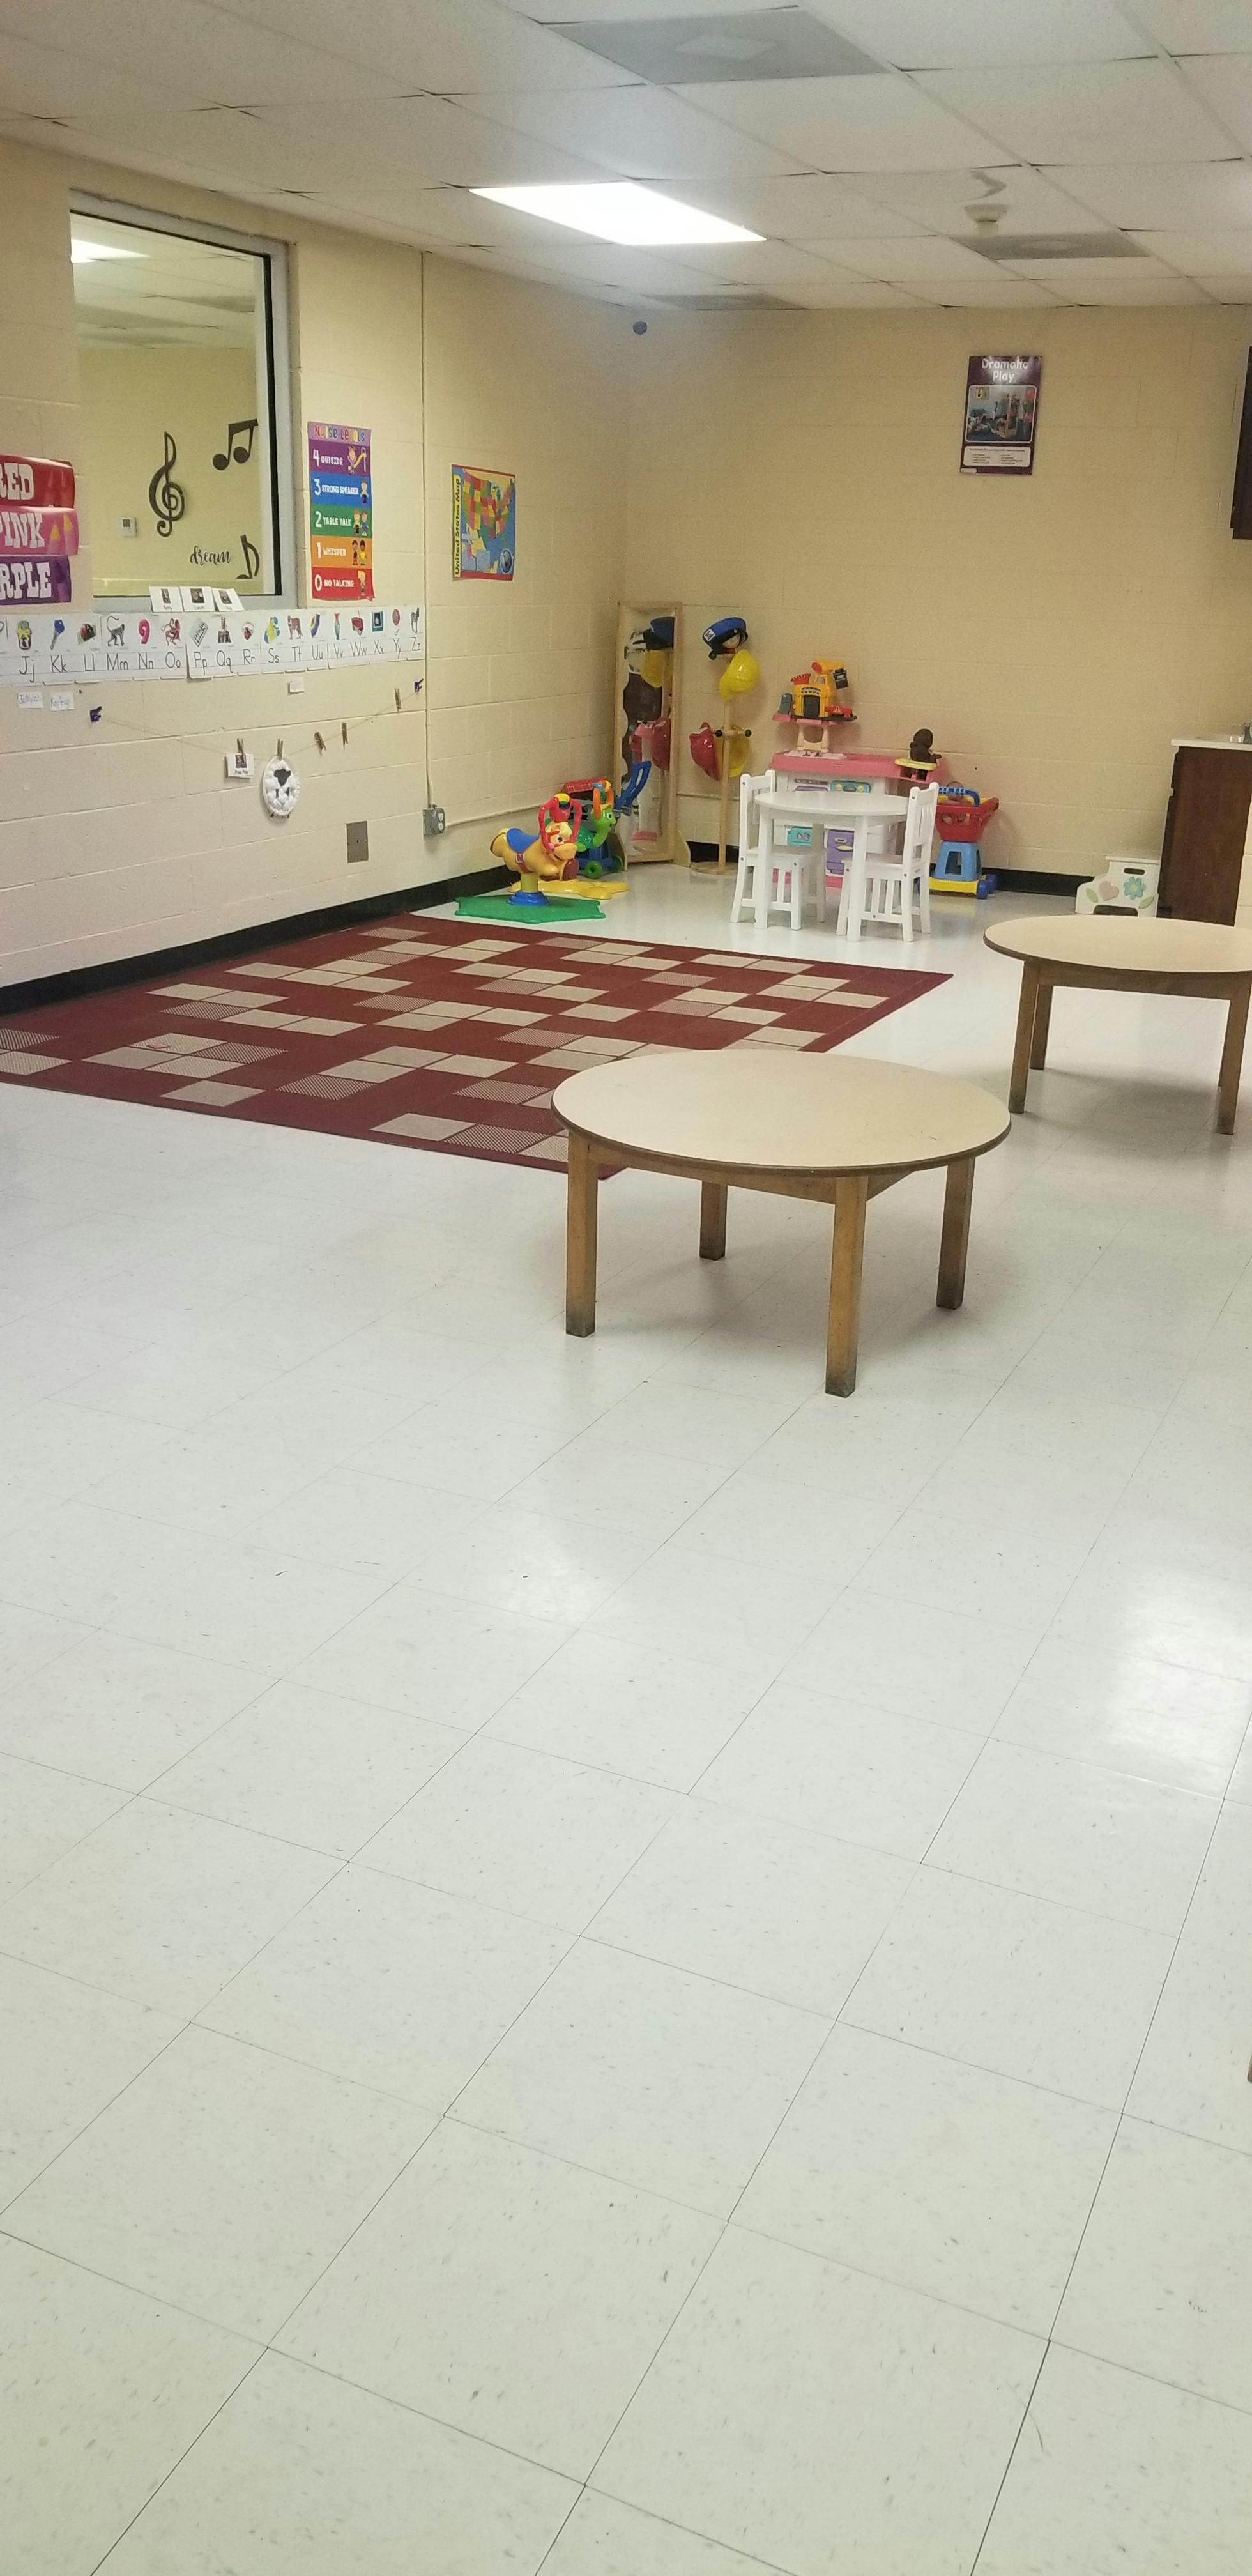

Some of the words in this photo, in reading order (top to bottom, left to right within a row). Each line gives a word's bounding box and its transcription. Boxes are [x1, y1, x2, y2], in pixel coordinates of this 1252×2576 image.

[982, 356, 1028, 369] Dramatic
[993, 371, 1015, 383] Play
[313, 449, 319, 467] 4
[321, 456, 343, 466] OUTSIDE
[314, 479, 321, 496] 3
[322, 484, 339, 494] STRONG
[340, 486, 359, 495] SPEAKER
[315, 511, 322, 528] 2
[323, 517, 339, 526] TABLE
[339, 518, 353, 526] TALK
[190, 545, 230, 566] dream
[316, 542, 321, 558] 1
[315, 574, 323, 592] 0
[333, 579, 354, 588] TALKING
[19, 656, 36, 683] Jj
[51, 655, 67, 673] Kk
[83, 654, 95, 671] Ll
[107, 653, 128, 671] Mm
[138, 652, 154, 670] Nn
[165, 651, 181, 668] Oo
[194, 651, 208, 675] Pp
[216, 650, 234, 673] Qq
[243, 648, 255, 665] Rr
[268, 648, 279, 664] Ss
[291, 645, 302, 661] Tt
[312, 644, 323, 660] Uu
[333, 643, 344, 659] Vv
[350, 641, 367, 657] Ww
[374, 640, 384, 654] Xx
[393, 638, 402, 659] Yy
[411, 636, 421, 651] Zz
